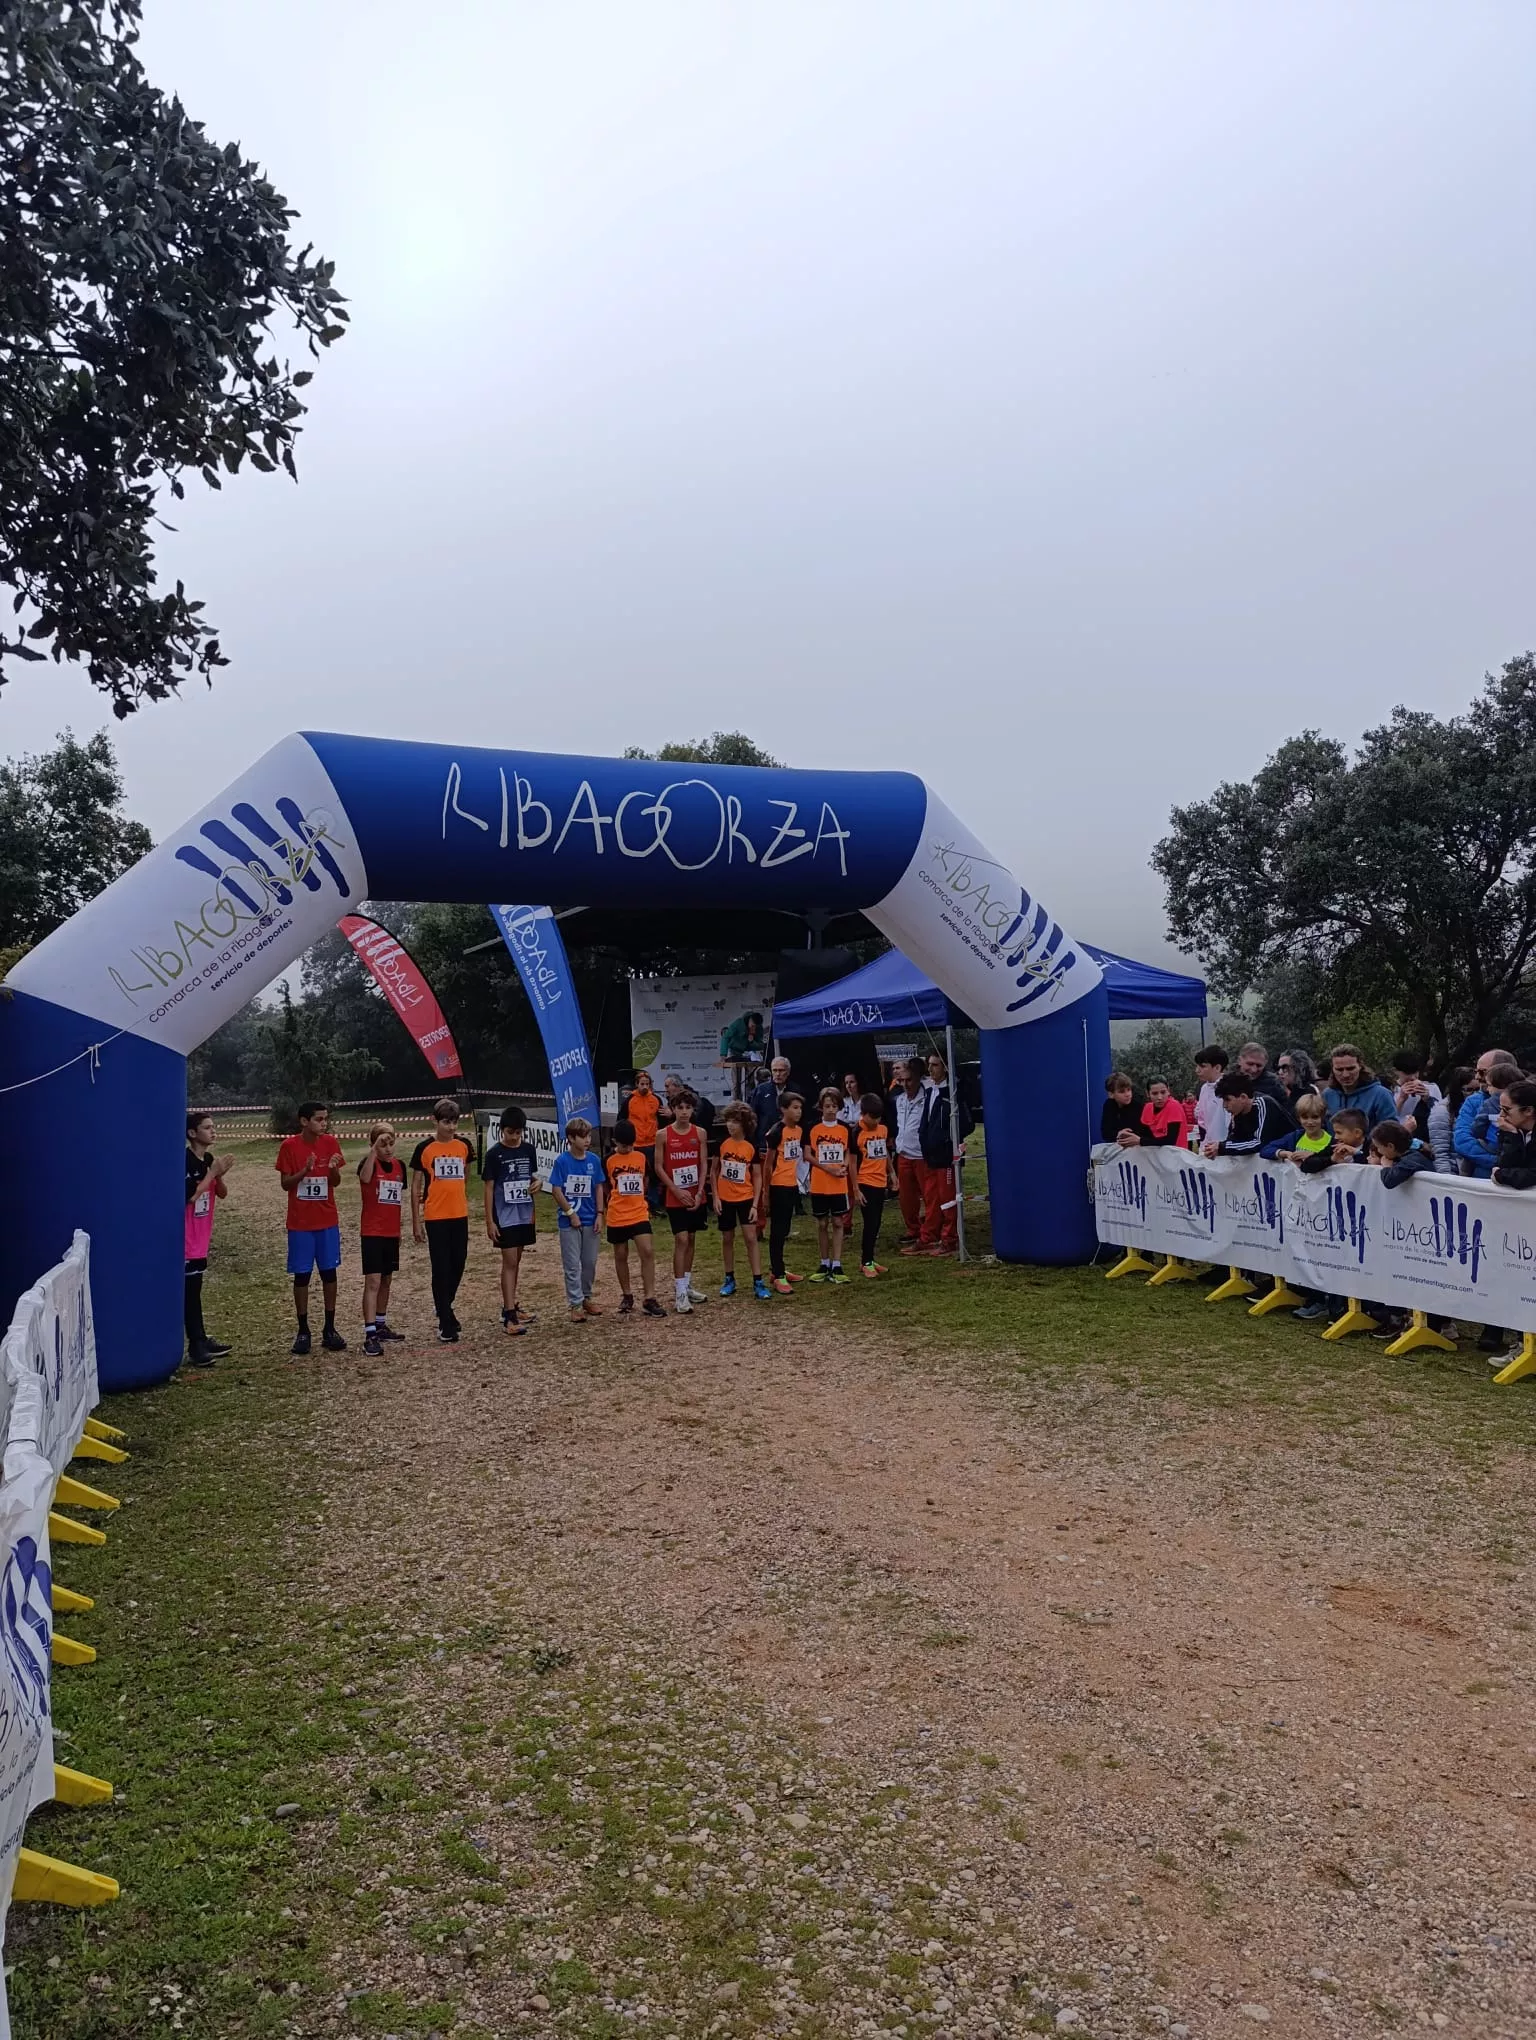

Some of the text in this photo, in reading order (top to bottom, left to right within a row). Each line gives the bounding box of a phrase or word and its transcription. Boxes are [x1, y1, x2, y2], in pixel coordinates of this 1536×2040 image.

[442, 762, 850, 876] RIBAGORZA
[108, 821, 346, 1007] RIBAGORZA
[918, 870, 1005, 961] comarca de la ribagoza
[940, 913, 996, 970] servicio de deportes
[210, 918, 293, 991] servicio de deportes
[149, 977, 202, 1023] comarca
[217, 953, 232, 965] la
[233, 907, 283, 953] ribagoza
[822, 1001, 884, 1026] RIBAGORZA
[823, 1151, 840, 1161] 137
[439, 1165, 459, 1175] 131
[726, 1168, 739, 1179] 68
[681, 1173, 693, 1184] 39
[306, 1185, 320, 1196] 19
[573, 1183, 586, 1193] 87
[623, 1181, 640, 1191] 102
[387, 1189, 398, 1200] 76
[509, 1188, 528, 1200] 129
